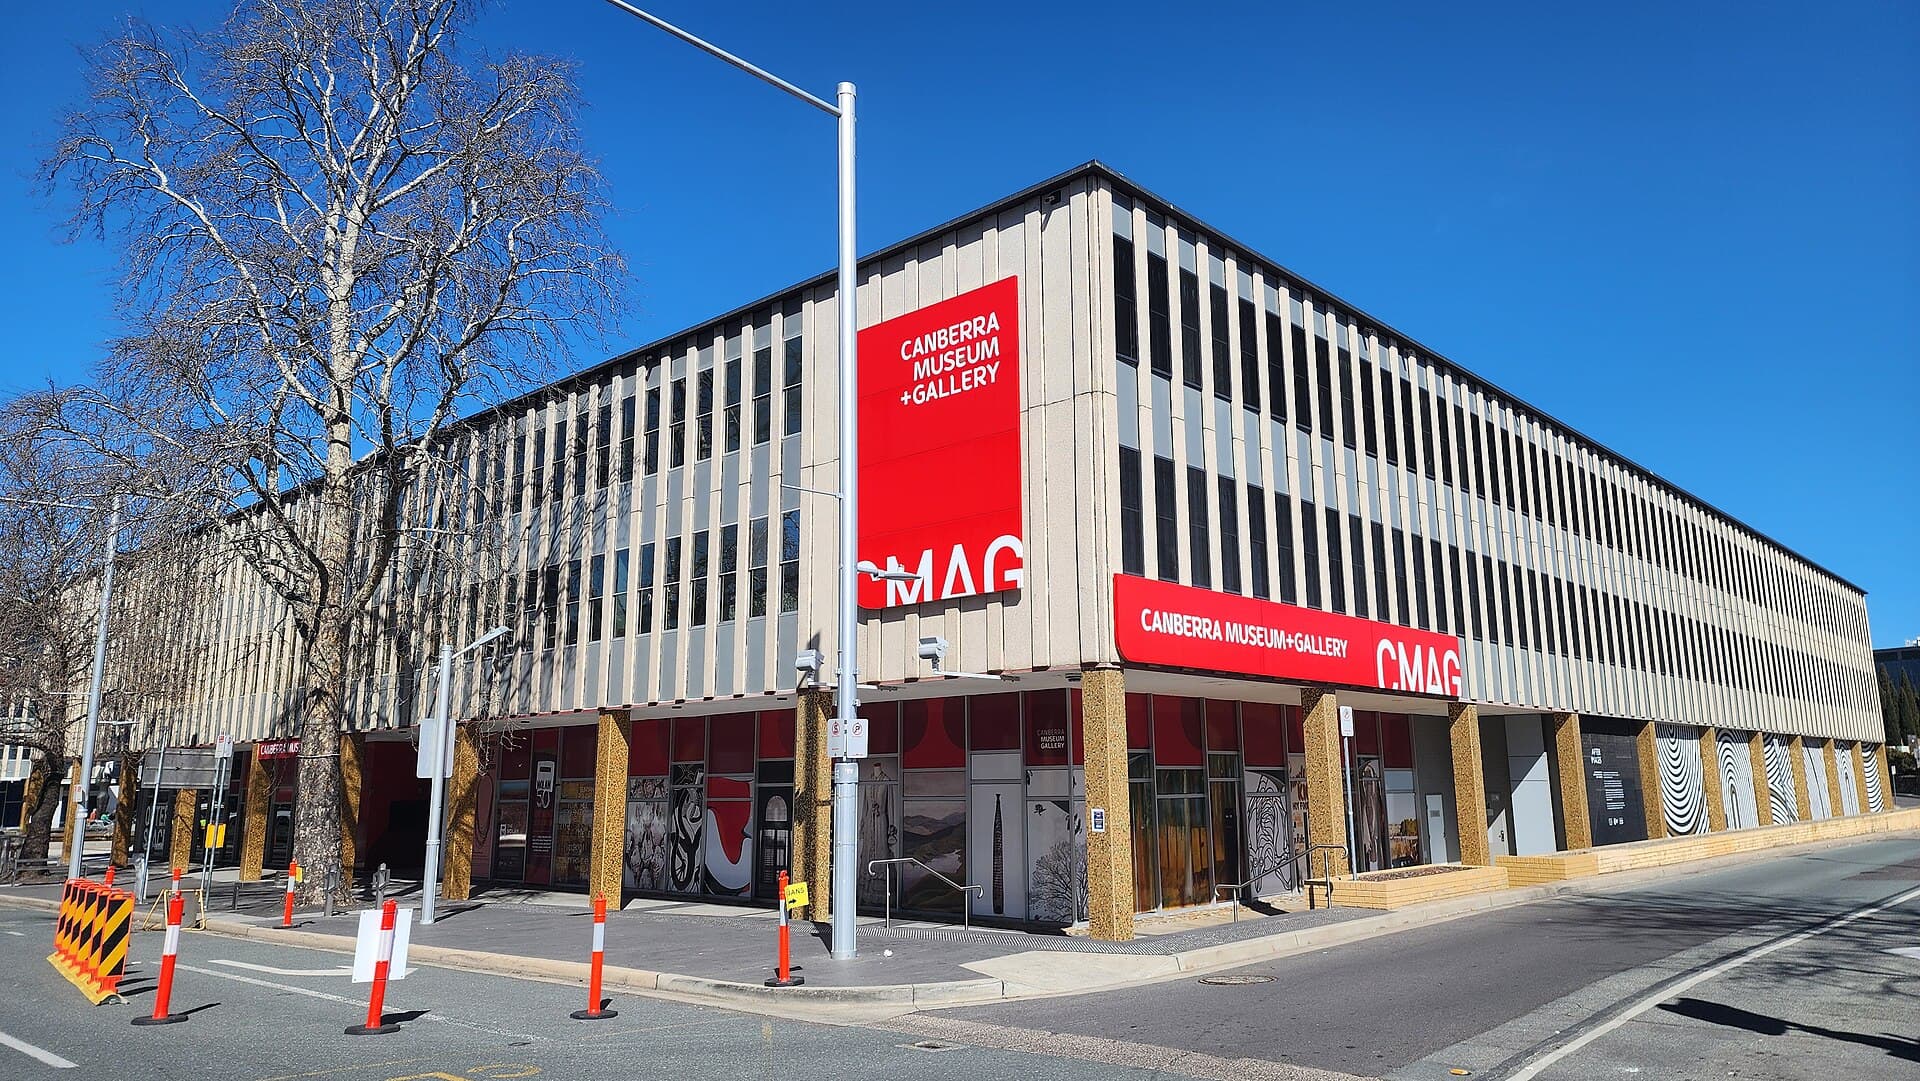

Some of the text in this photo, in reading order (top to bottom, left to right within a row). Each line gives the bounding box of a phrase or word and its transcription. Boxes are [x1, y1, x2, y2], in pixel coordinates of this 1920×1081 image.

[901, 311, 1000, 361] CANBERRA
[913, 336, 1000, 382] MUSEUM
[901, 360, 1000, 406] +GALLERY
[1140, 608, 1348, 658] CANBERRA MUSEUM+GALLERY
[1376, 638, 1462, 698] CMAG
